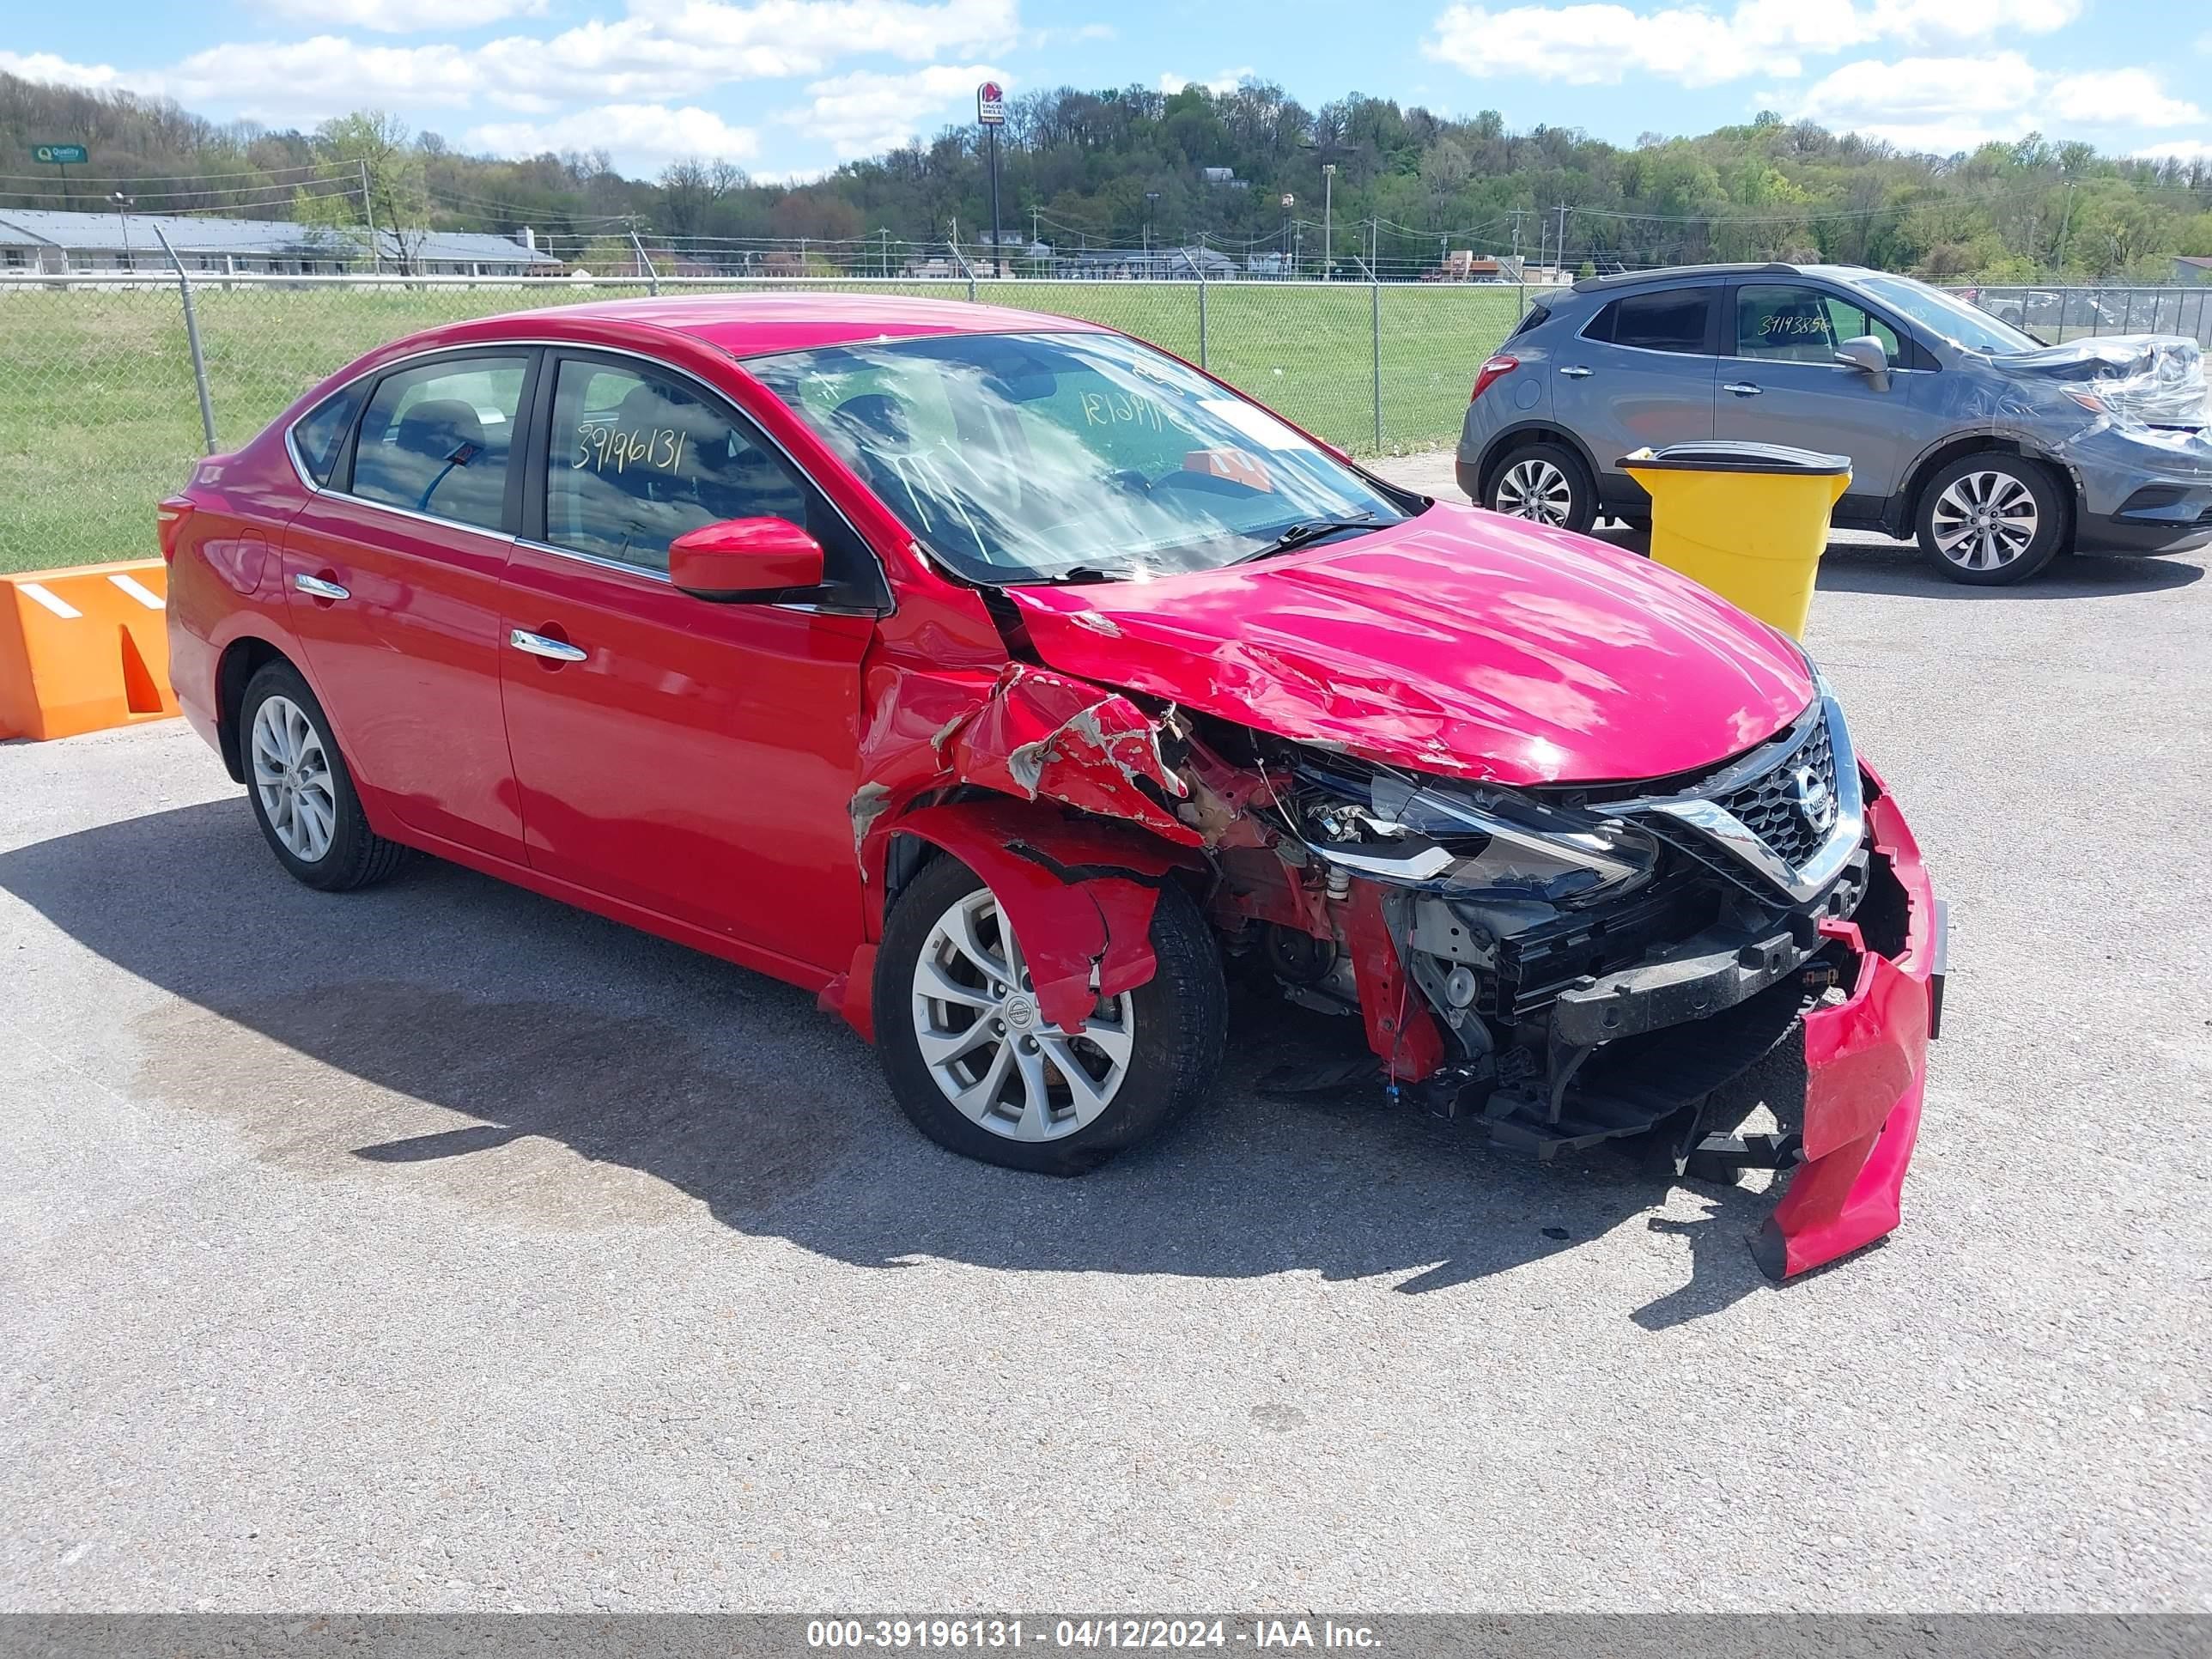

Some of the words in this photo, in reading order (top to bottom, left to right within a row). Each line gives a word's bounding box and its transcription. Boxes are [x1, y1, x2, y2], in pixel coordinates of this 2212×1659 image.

[52, 147, 79, 157] Quality
[1758, 315, 1832, 336] 39193856
[571, 423, 686, 475] 39196131
